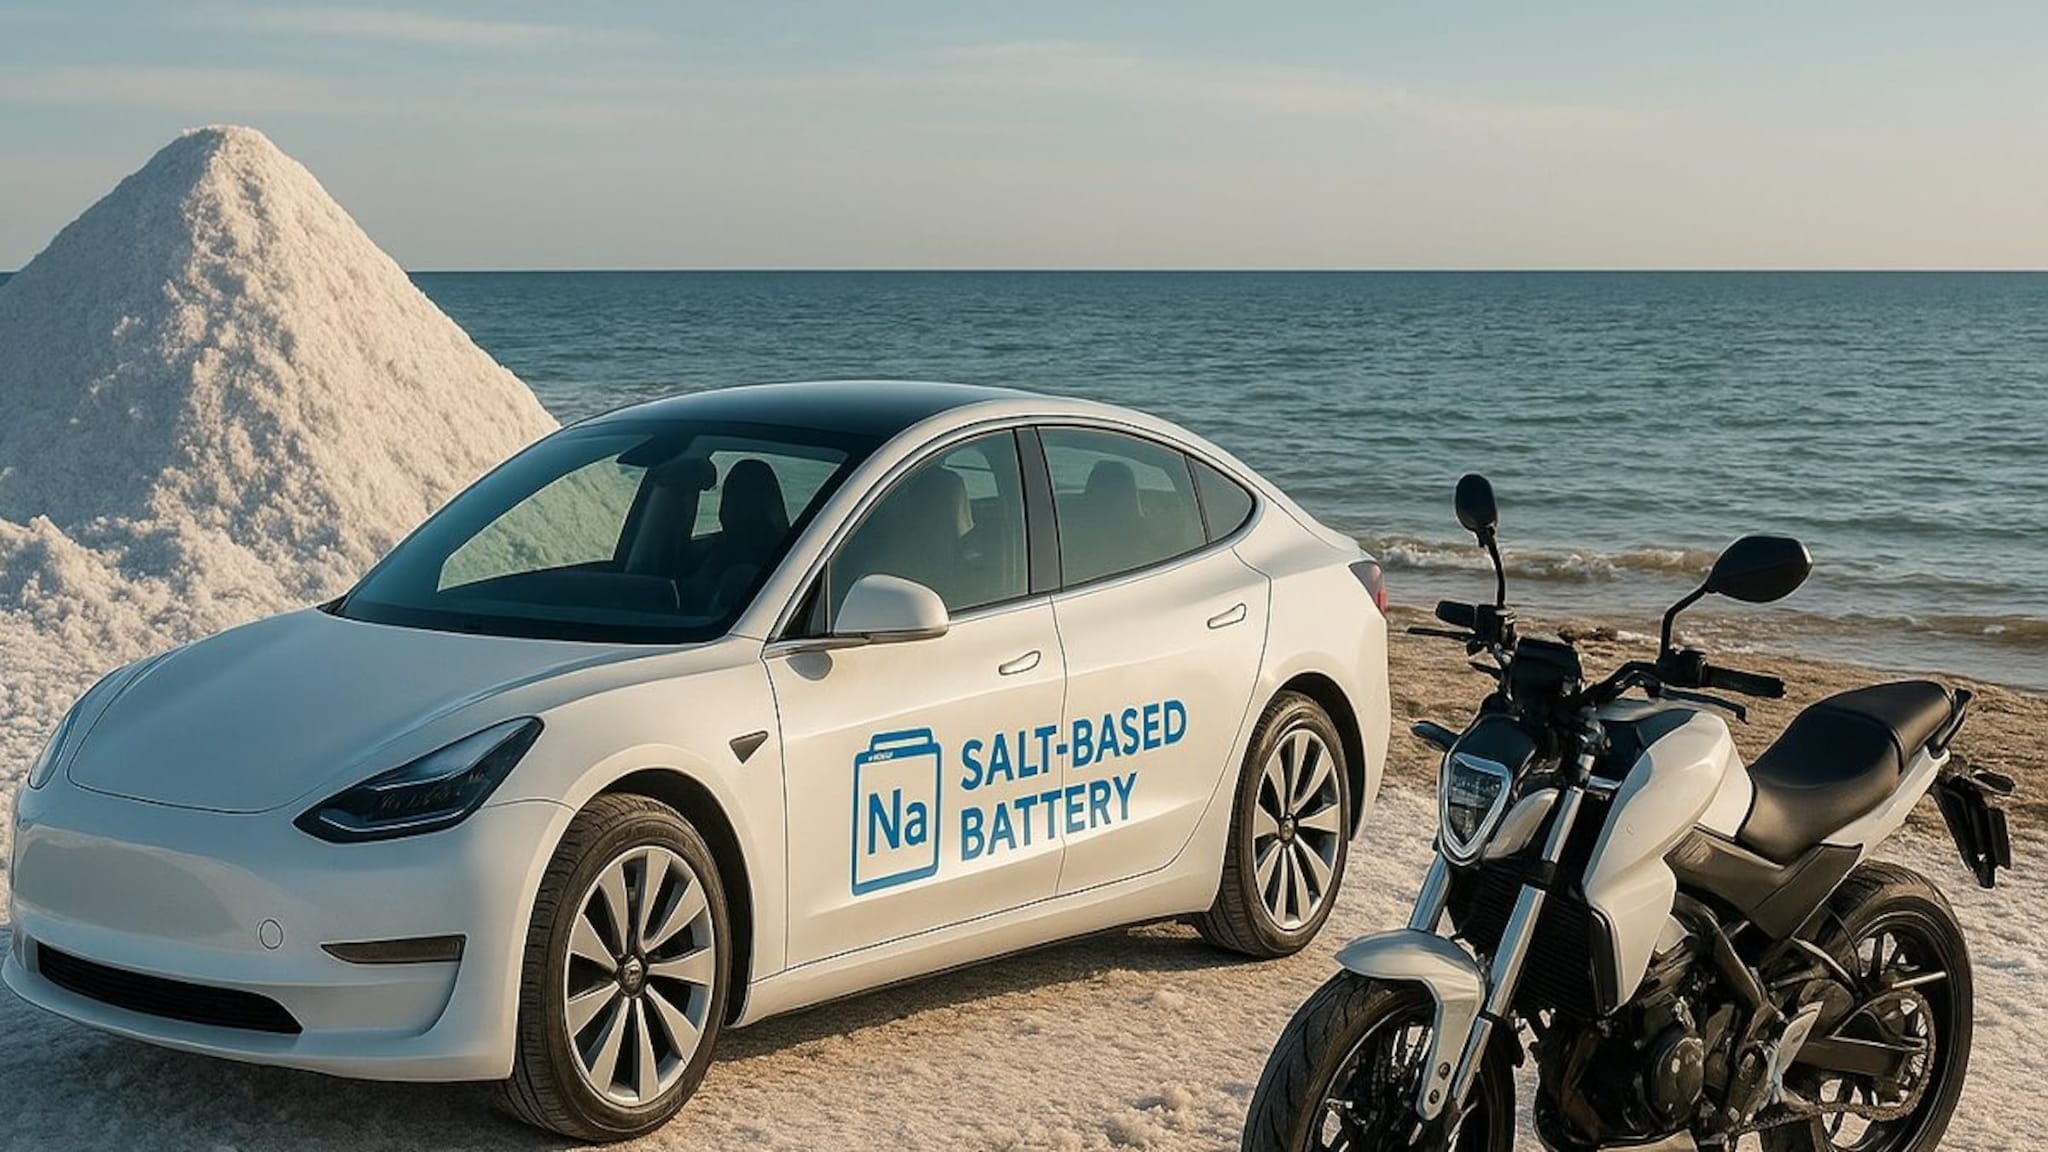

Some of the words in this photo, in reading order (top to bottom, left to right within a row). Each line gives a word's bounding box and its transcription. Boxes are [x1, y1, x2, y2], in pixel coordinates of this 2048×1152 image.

[961, 700, 1187, 791] SALT-BASED
[867, 789, 928, 855] Na
[961, 772, 1137, 861] BATTERY
